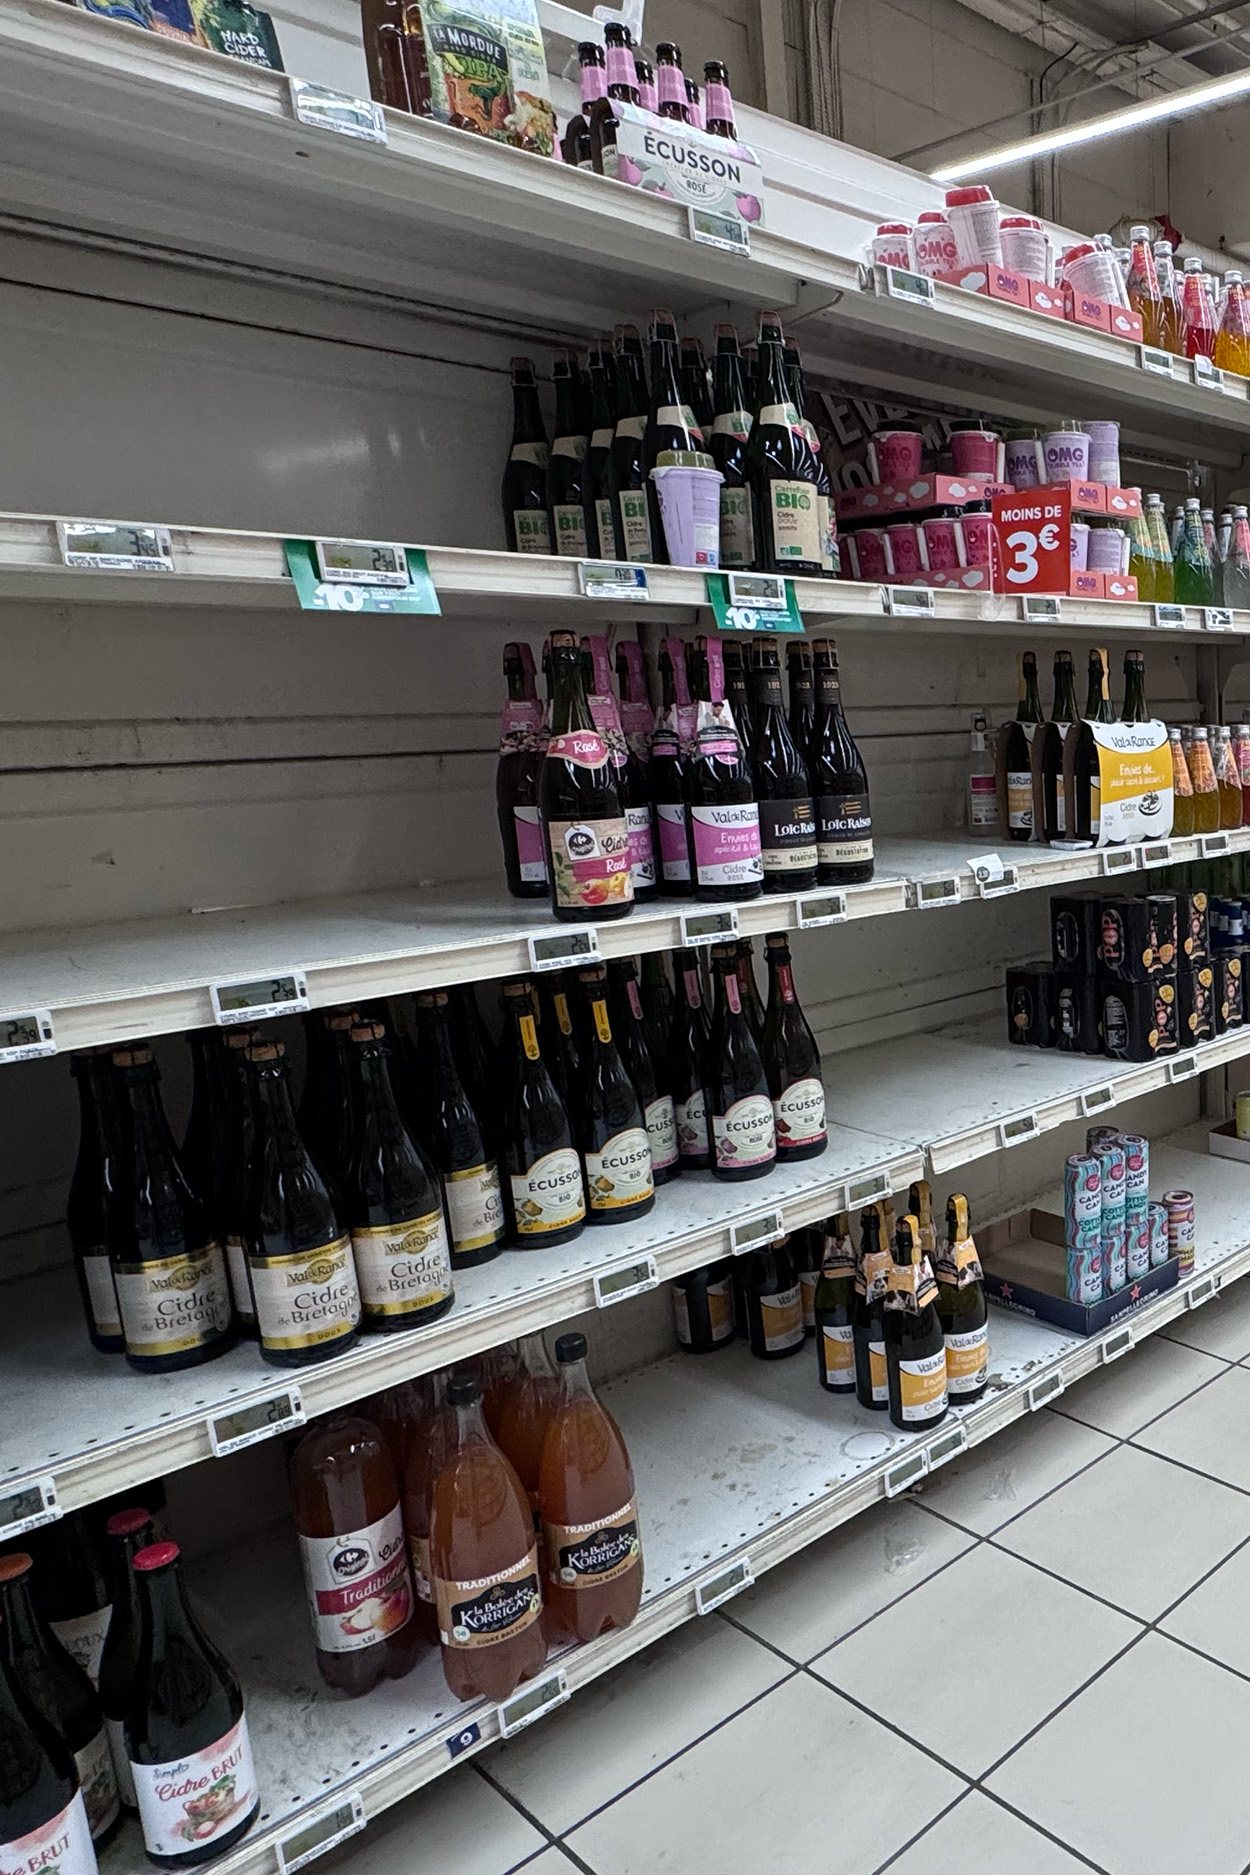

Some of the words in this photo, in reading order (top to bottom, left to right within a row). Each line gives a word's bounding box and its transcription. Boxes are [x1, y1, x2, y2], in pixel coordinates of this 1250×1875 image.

[221, 30, 259, 46] HARD
[447, 27, 501, 59] MORDUE
[224, 42, 266, 58] CIDER
[644, 131, 742, 183] ÉCUSSON
[916, 241, 958, 260] OMG
[1048, 447, 1084, 462] OMG
[625, 502, 645, 518] BI
[775, 492, 811, 511] BIO
[1001, 507, 1042, 522] MOINS
[1045, 505, 1062, 519] DE
[1005, 523, 1060, 584] 3€
[572, 738, 600, 755] Rosé
[1119, 764, 1142, 776] Envies
[1119, 802, 1137, 812] Cidre
[605, 858, 627, 873] Rosé
[722, 864, 746, 875] Cidre
[726, 1112, 773, 1132] ÉCUSSON
[1104, 1182, 1124, 1193] CAND
[1127, 1179, 1145, 1188] CAN
[1079, 1193, 1099, 1205] CAND
[1103, 1207, 1125, 1215] COTT
[1105, 1212, 1125, 1221] CAND
[1079, 1218, 1100, 1227] COTT
[1081, 1223, 1100, 1233] CAND
[391, 1254, 441, 1279] Cidre
[388, 1263, 450, 1291] Bretagne
[157, 1291, 215, 1316] Cidre
[294, 1283, 349, 1310] Cidre
[154, 1305, 219, 1330] Bretag
[291, 1292, 359, 1325] Bretagne
[563, 1503, 632, 1534] TRADITIONNEL
[567, 1533, 635, 1570] KORRIGANS
[456, 1555, 531, 1591] TRADITIONNEL
[339, 1561, 407, 1605] Tradition
[460, 1588, 535, 1628] KORRIGANS
[155, 1776, 211, 1801] Cidre
[211, 1745, 243, 1780] BRUT
[28, 1833, 71, 1873] BRUT
